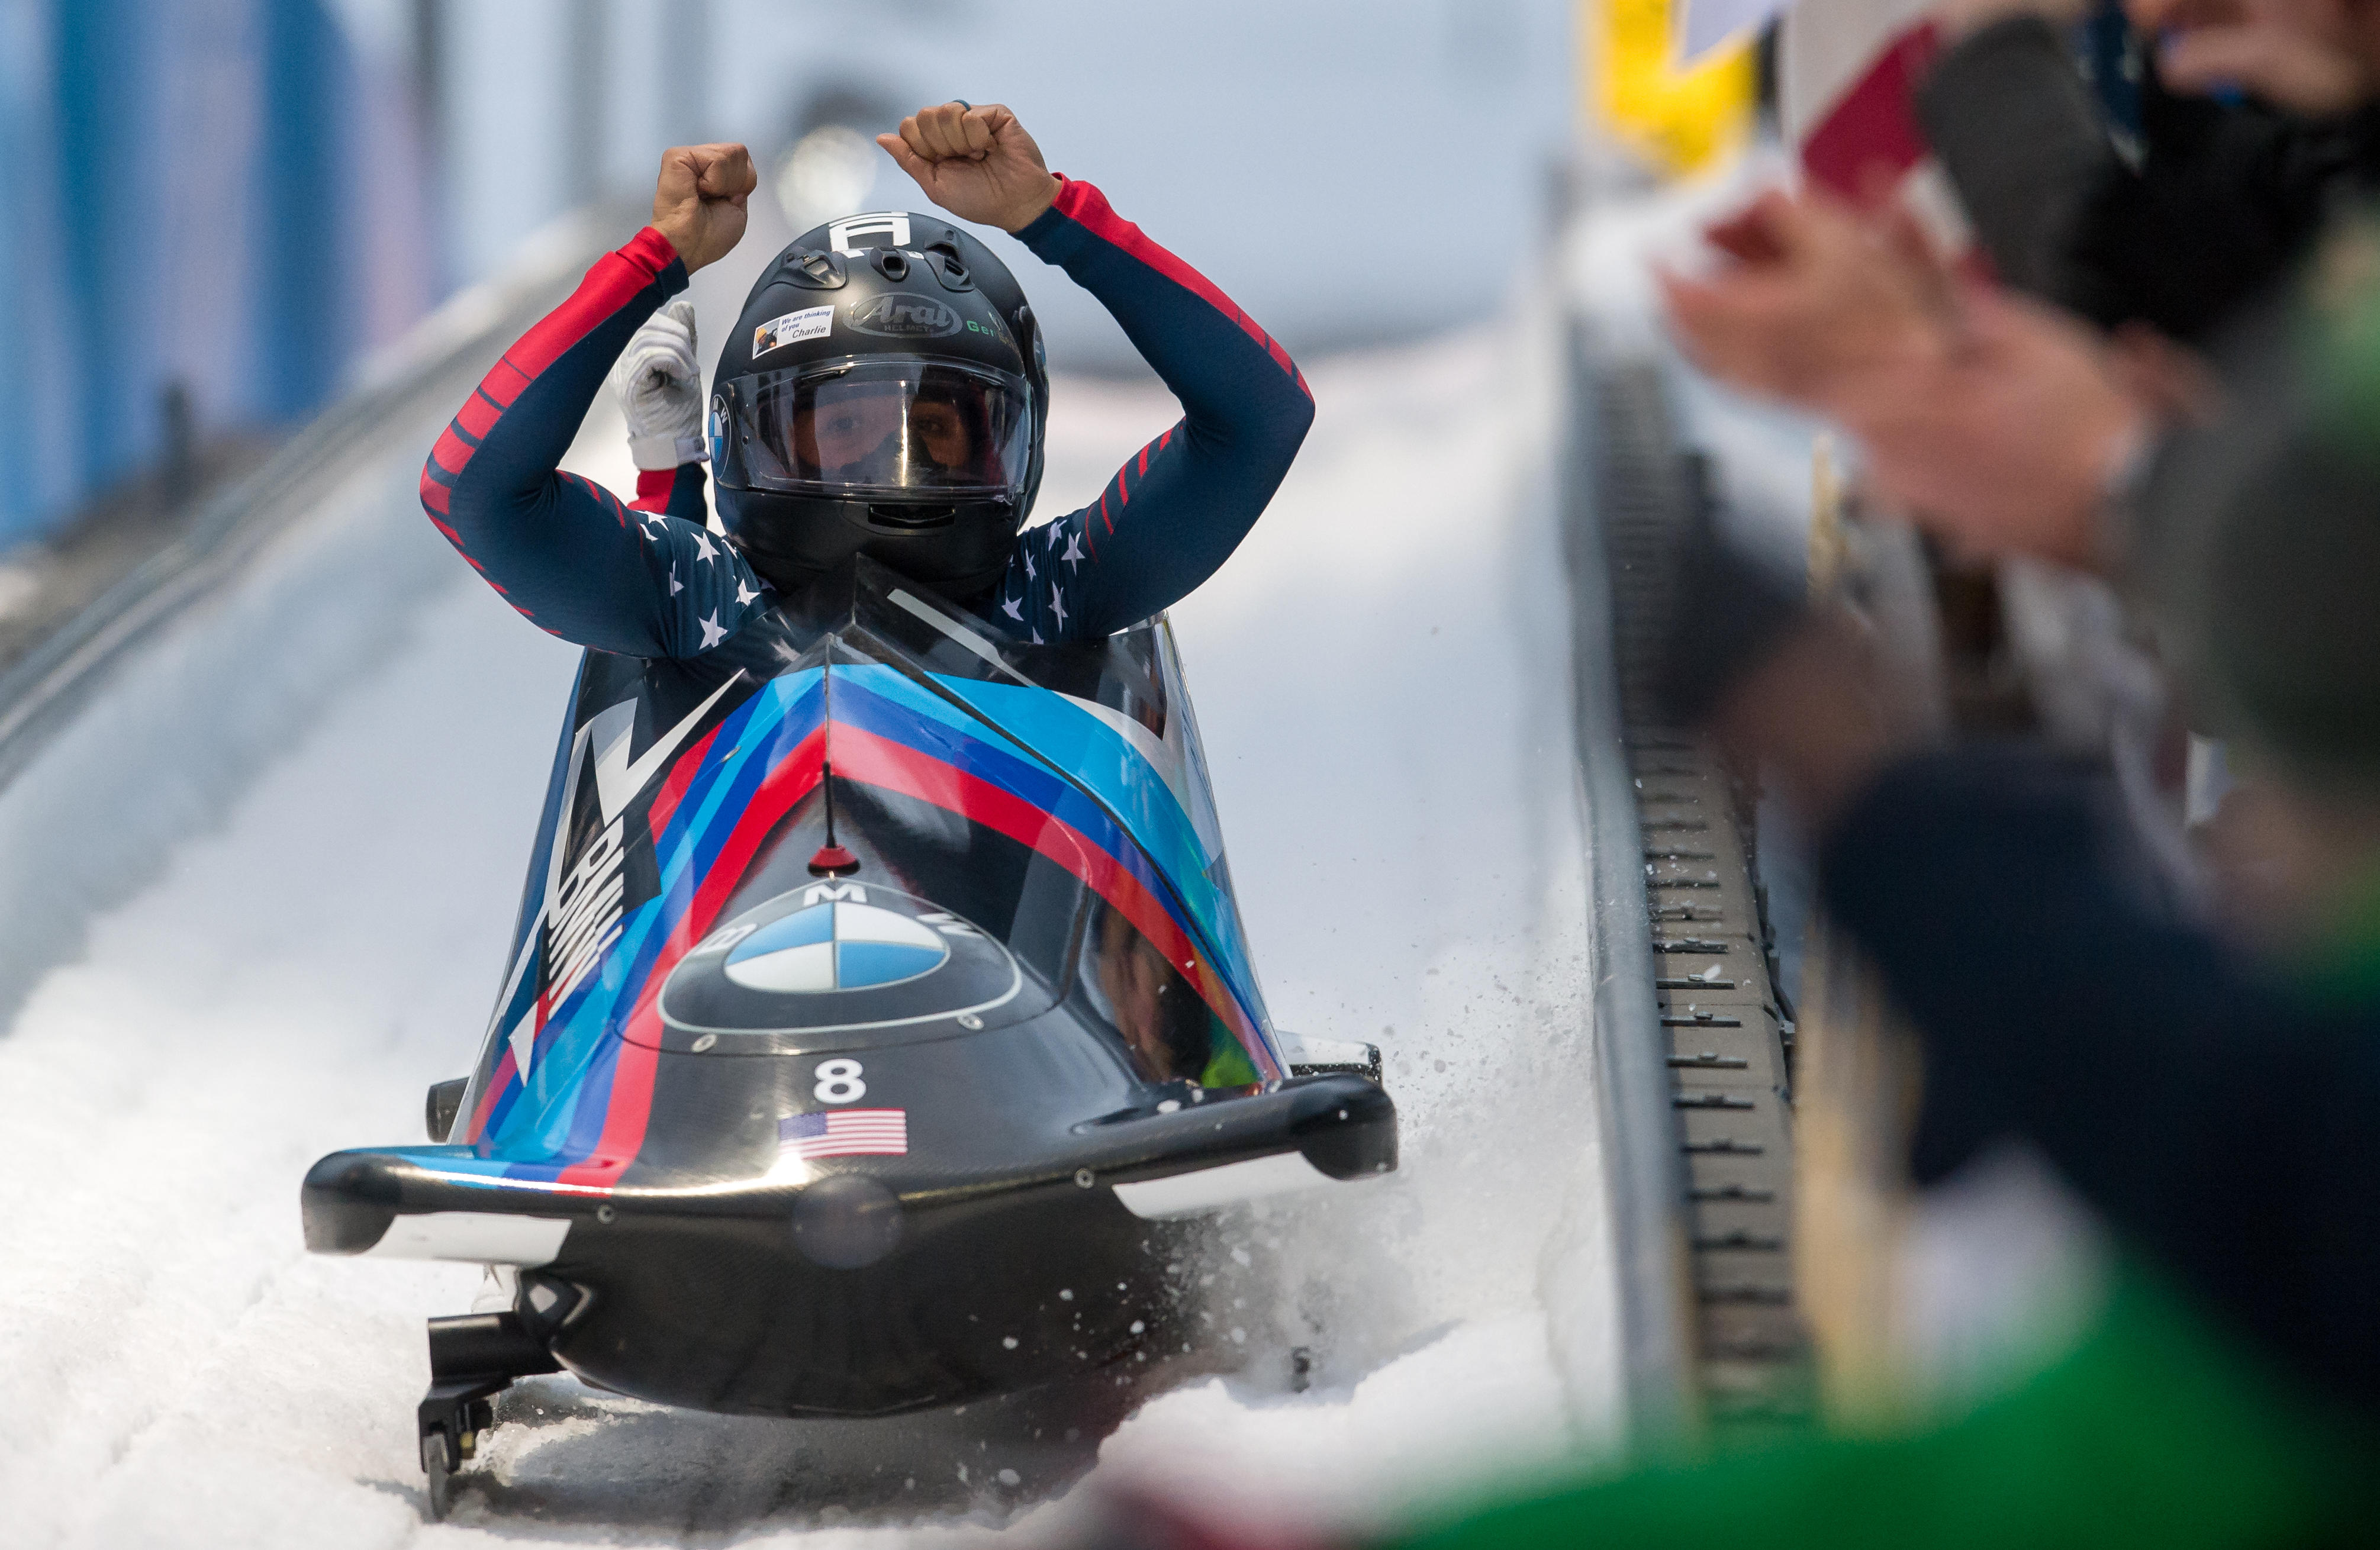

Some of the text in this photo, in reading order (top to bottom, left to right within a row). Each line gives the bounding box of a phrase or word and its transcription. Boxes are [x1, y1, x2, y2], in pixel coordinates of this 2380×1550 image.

[781, 317, 791, 326] We
[804, 310, 830, 319] thinking
[854, 295, 954, 327] Arai
[788, 322, 800, 331] you
[792, 325, 826, 338] Charlie
[694, 883, 985, 955] BMW
[813, 1058, 867, 1104] 8
